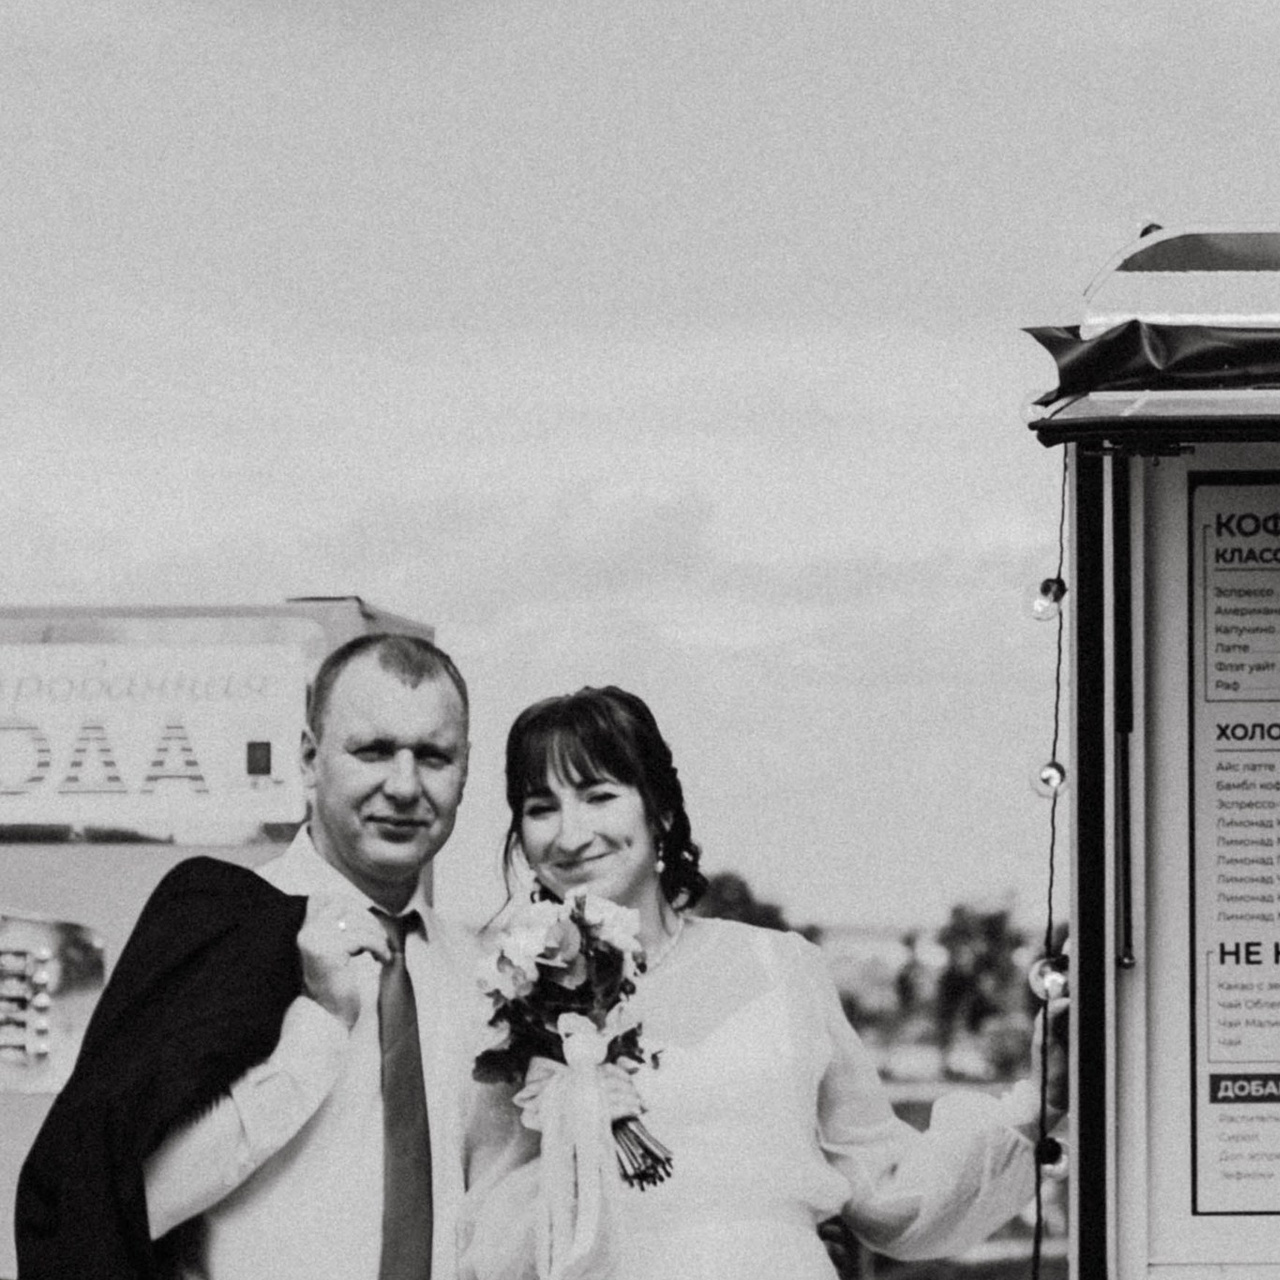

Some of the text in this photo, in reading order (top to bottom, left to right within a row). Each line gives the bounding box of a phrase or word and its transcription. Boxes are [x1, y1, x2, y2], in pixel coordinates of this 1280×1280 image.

[1214, 586, 1274, 597] Эспрессо
[1215, 624, 1276, 636] Капучино
[1215, 642, 1250, 653] Латте
[1215, 679, 1240, 691] Раф
[1216, 761, 1240, 772] Айс
[1243, 762, 1275, 772] латте
[1216, 779, 1256, 790] Бамбл
[1216, 817, 1274, 830] Лимонад
[1216, 836, 1274, 848] Лимонад
[1216, 854, 1274, 866] Лимонад
[1216, 873, 1274, 885] Лимонад
[1216, 891, 1274, 904] Лимонад
[1216, 910, 1274, 922] Лимонад
[1219, 941, 1262, 964] НЕ
[1218, 980, 1255, 991] Какао
[1218, 999, 1242, 1009] Чай
[1218, 1018, 1242, 1028] Чай
